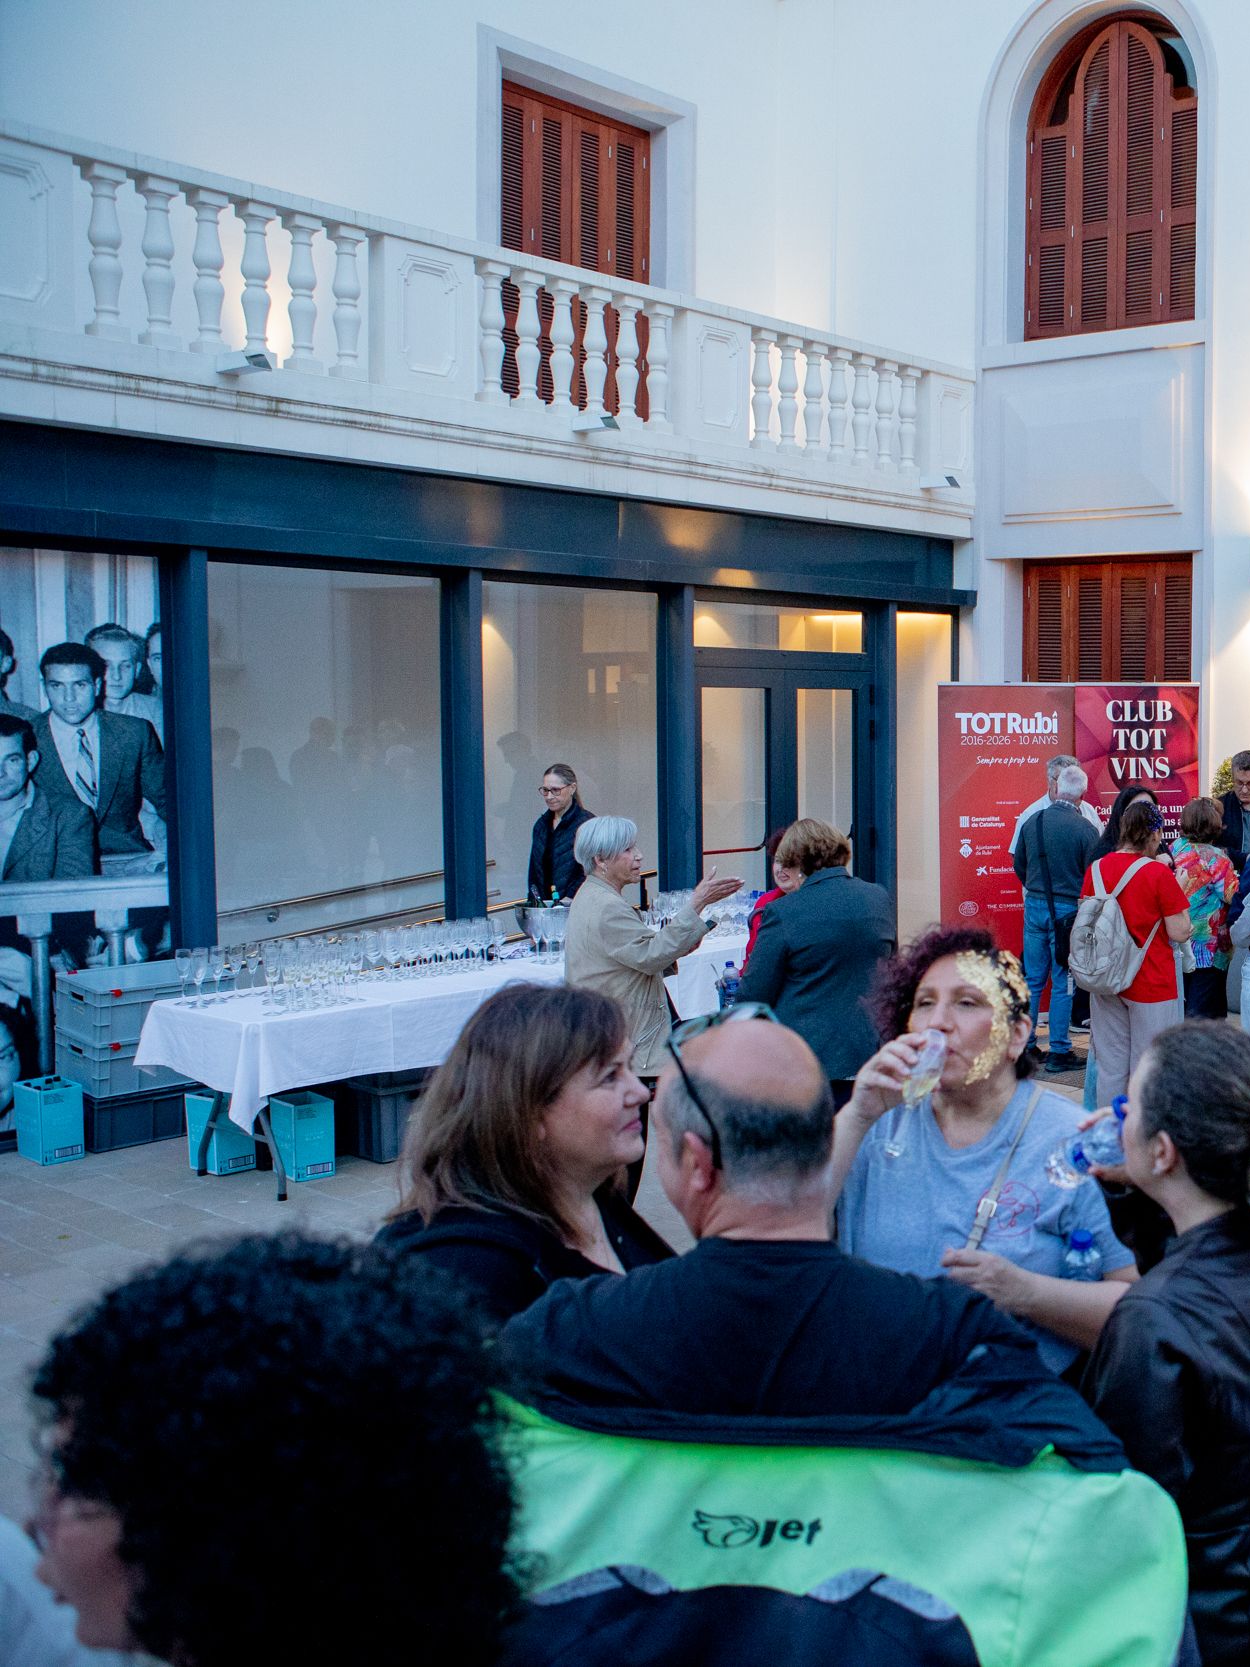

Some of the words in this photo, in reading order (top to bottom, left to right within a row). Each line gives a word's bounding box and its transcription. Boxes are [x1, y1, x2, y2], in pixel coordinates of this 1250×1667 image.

[1106, 700, 1173, 722] CLUB
[960, 735, 1010, 746] 2016-2026
[1019, 736, 1029, 745] 10
[1032, 735, 1059, 745] ANYS
[1112, 728, 1166, 751] TOT
[976, 755, 1003, 768] Sempre
[1007, 756, 1025, 768] prop
[1027, 755, 1039, 764] teu
[1110, 757, 1170, 779] VINS
[1094, 804, 1112, 815] Cad
[1169, 805, 1185, 813] un
